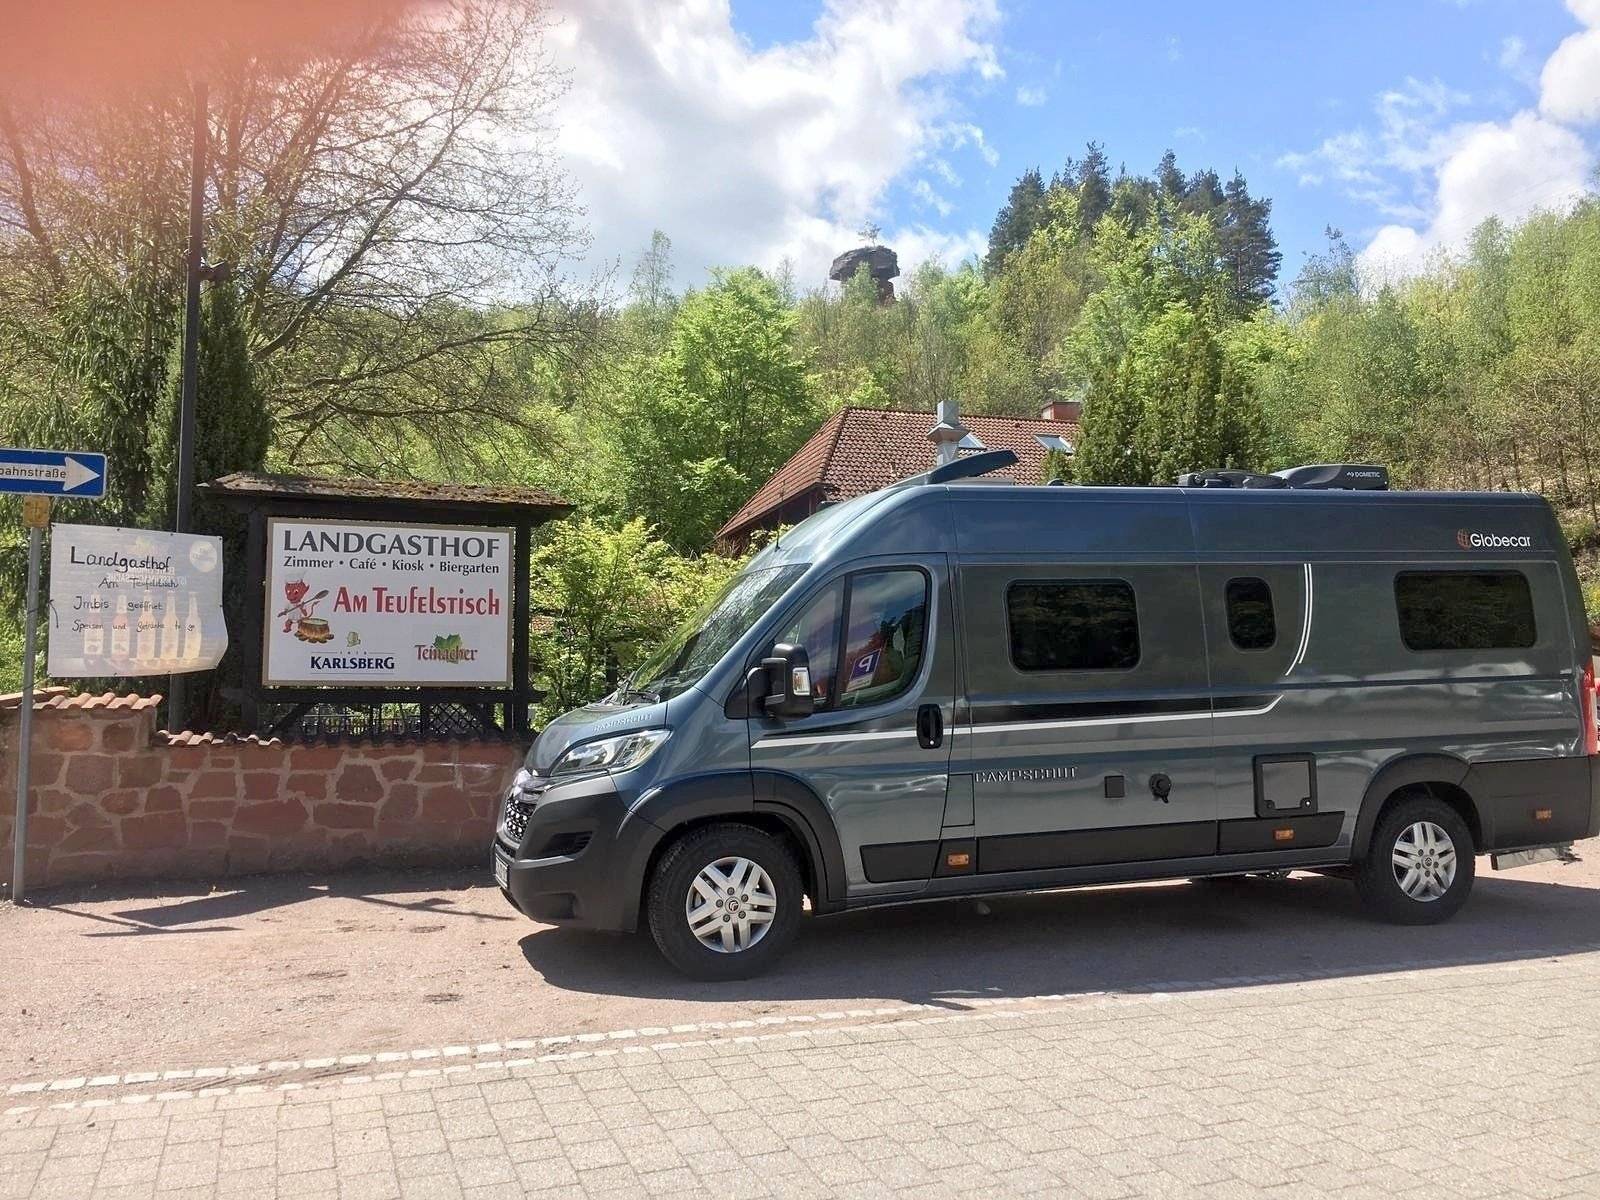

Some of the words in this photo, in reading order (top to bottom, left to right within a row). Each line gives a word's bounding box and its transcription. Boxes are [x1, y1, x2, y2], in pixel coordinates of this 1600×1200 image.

[284, 530, 500, 558] LANDGASTHOF
[1470, 533, 1531, 547] Globecar
[70, 546, 171, 573] Landgasthof
[283, 556, 334, 569] Zimmer
[349, 558, 377, 570] Café
[392, 560, 424, 571] Kiosk
[439, 561, 500, 576] Biergarten
[98, 577, 119, 589] Am
[310, 656, 395, 670] KARLSBERG
